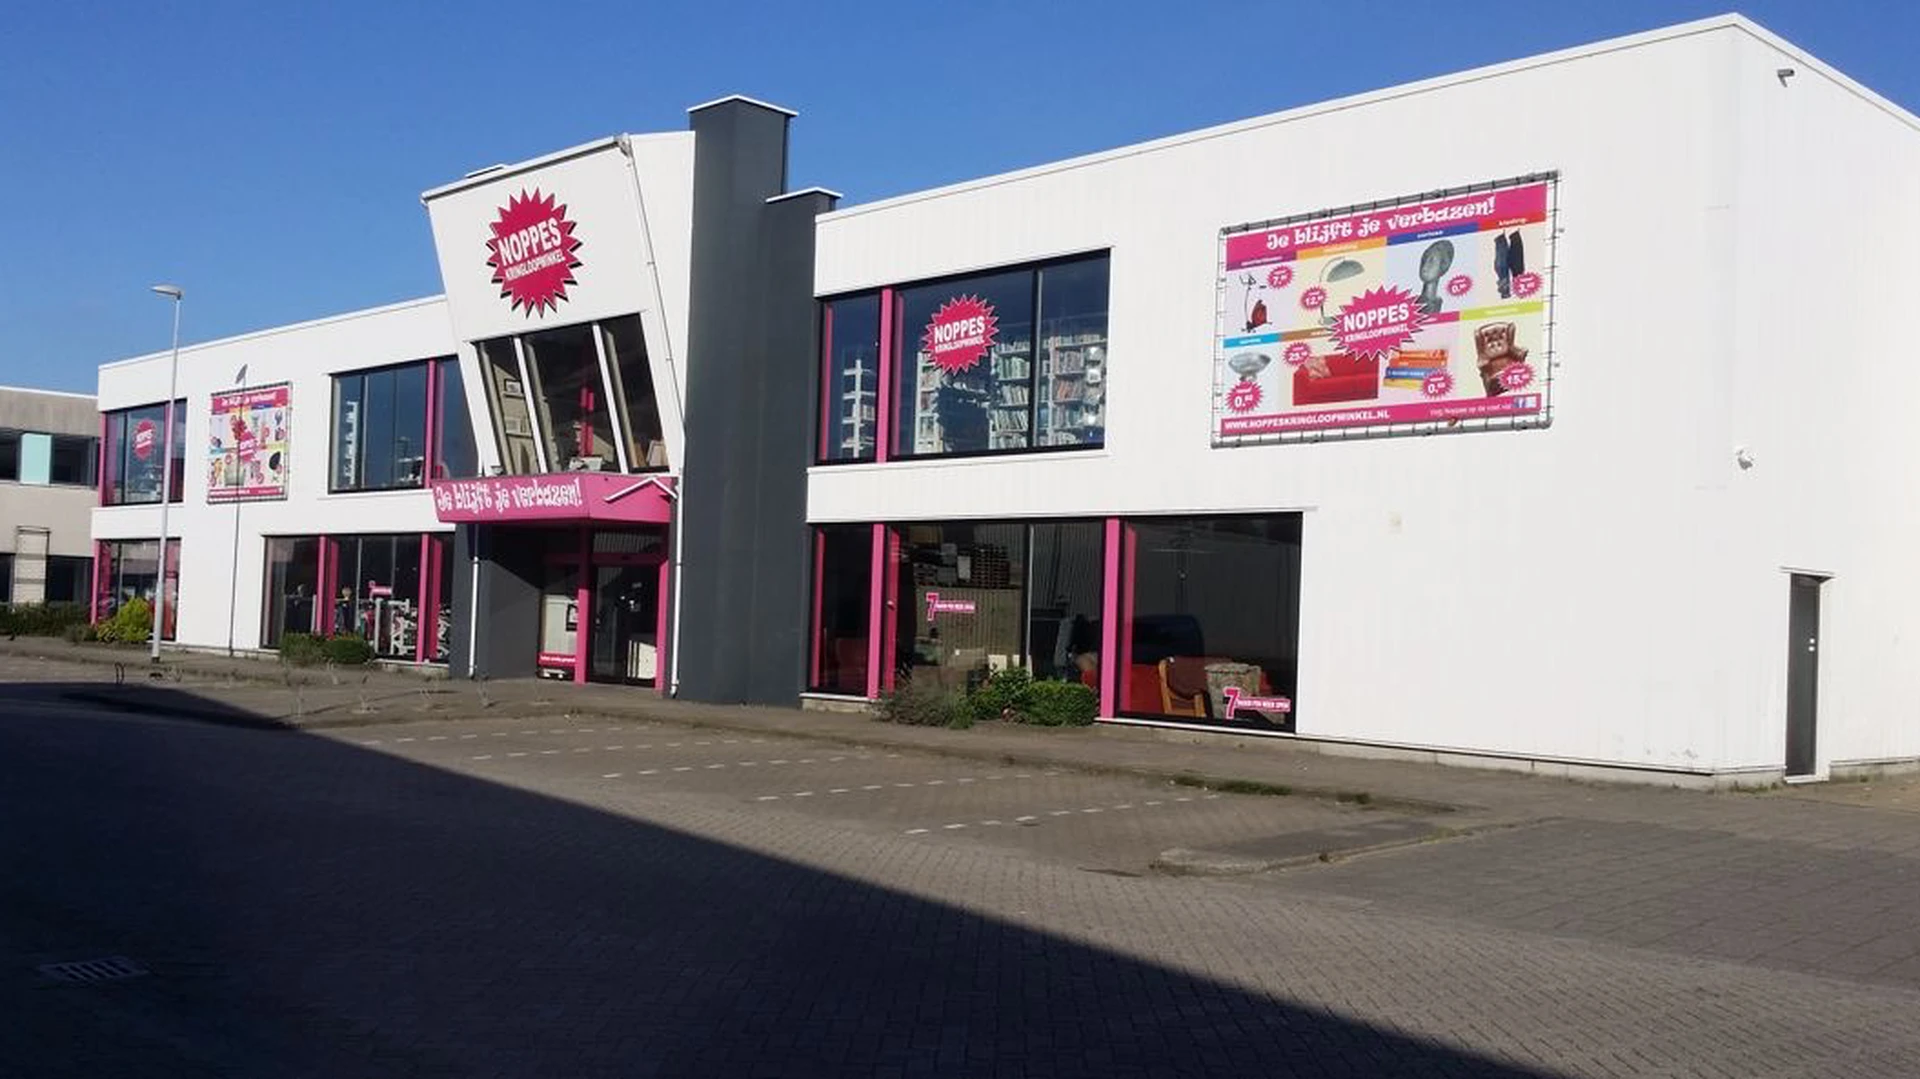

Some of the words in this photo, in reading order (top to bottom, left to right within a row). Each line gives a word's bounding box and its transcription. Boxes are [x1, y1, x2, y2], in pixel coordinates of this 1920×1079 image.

[1266, 234, 1290, 250] Je
[1294, 220, 1353, 244] blijft
[1357, 217, 1381, 237] je
[1386, 196, 1496, 230] verbazen!
[498, 217, 561, 267] NOPPES
[934, 315, 985, 344] NOPPES
[1343, 303, 1409, 332] NOPPES
[436, 486, 453, 511] Je
[453, 481, 492, 514] blijft
[495, 482, 510, 512] je
[512, 477, 583, 508] verbazen!
[1224, 687, 1240, 719] 7
